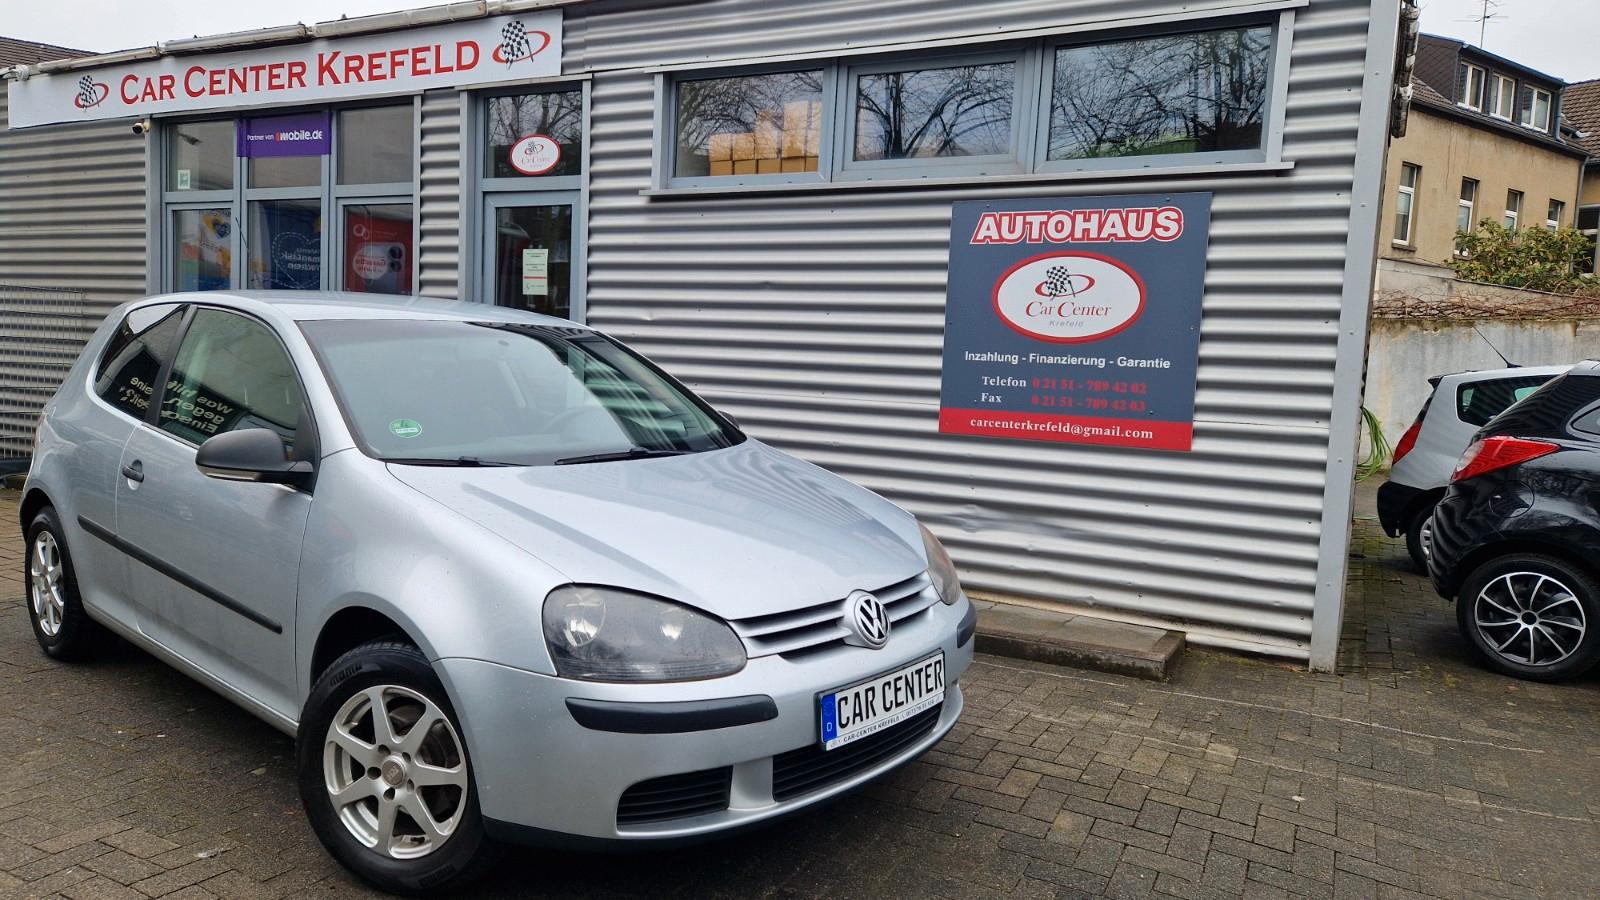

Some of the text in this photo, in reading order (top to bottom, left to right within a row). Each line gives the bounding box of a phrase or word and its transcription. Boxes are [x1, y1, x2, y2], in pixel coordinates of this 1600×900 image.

[120, 40, 480, 105] CAR CENTER KREFELD
[280, 129, 322, 141] mobile.de
[971, 207, 1183, 244] AUTOHAUS
[1025, 301, 1111, 318] Car Center
[965, 351, 1019, 365] Inzahlung
[1029, 353, 1106, 368] Finanzierung
[1117, 356, 1170, 368] Garantie
[982, 376, 1027, 387] Telefon
[1032, 377, 1040, 389] 0
[981, 393, 1002, 403] Fax
[1031, 395, 1039, 405] 0
[970, 417, 1153, 440] carcenterkrefeld@gmail.com
[837, 659, 943, 729] CAR CENTER
[826, 722, 833, 732] D
